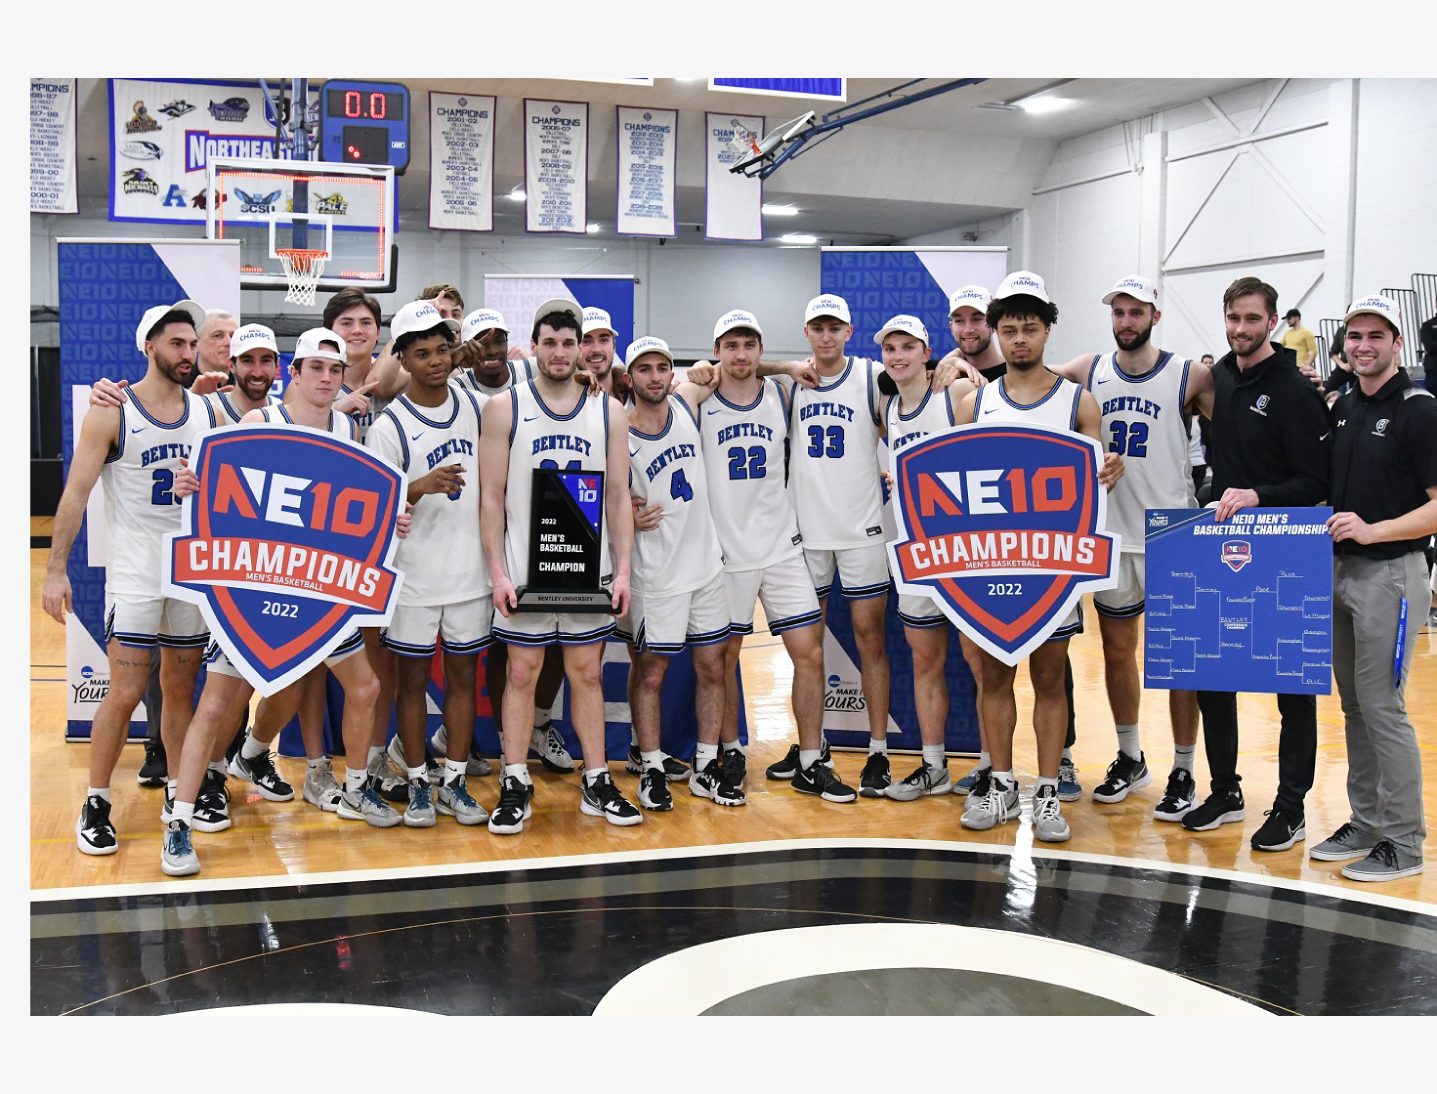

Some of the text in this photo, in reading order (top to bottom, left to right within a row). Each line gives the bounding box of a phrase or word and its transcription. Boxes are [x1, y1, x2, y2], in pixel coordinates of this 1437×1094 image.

[345, 91, 386, 119] 0.0
[436, 107, 489, 119] CHAMPIONS
[531, 115, 581, 127] CHAMPIONS
[624, 122, 671, 134] CHAMPIONS
[315, 201, 348, 212] PACE
[1355, 299, 1391, 312] CHAMPS
[239, 331, 271, 342] CHAMPS
[799, 402, 855, 423] BENTLEY
[1102, 396, 1162, 421] BENTLEY
[718, 422, 774, 446] BENTLEY
[1108, 420, 1150, 459] 32
[531, 434, 593, 457] BENTLEY
[807, 425, 846, 459] 33
[645, 443, 696, 483] BENTLEY
[727, 445, 768, 481] 22
[577, 477, 598, 490] NE
[670, 467, 695, 503] 4
[578, 489, 598, 503] 10
[917, 465, 1078, 517] NE10
[212, 463, 380, 538] NE10
[540, 517, 557, 526] 2022
[1231, 513, 1289, 525] NE10 MEN'S
[1193, 524, 1329, 536] BASKETBALL CHAMPIONSHIP
[539, 533, 566, 543] MEN'S
[539, 543, 585, 554] BASKETBALL
[909, 531, 1097, 570] CHAMPIONS
[1225, 545, 1249, 553] NE10
[188, 539, 382, 599] CHAMPIONS
[538, 561, 586, 573] CHAMPION
[965, 559, 1042, 570] MEN'S BASKETBALL
[245, 571, 325, 592] MEN'S BASKETBALL
[987, 583, 1023, 596] 2022
[562, 595, 594, 603] UNIVERSITY
[261, 600, 300, 619] 2022
[89, 679, 111, 687] MAKE
[835, 688, 859, 696] MAKE
